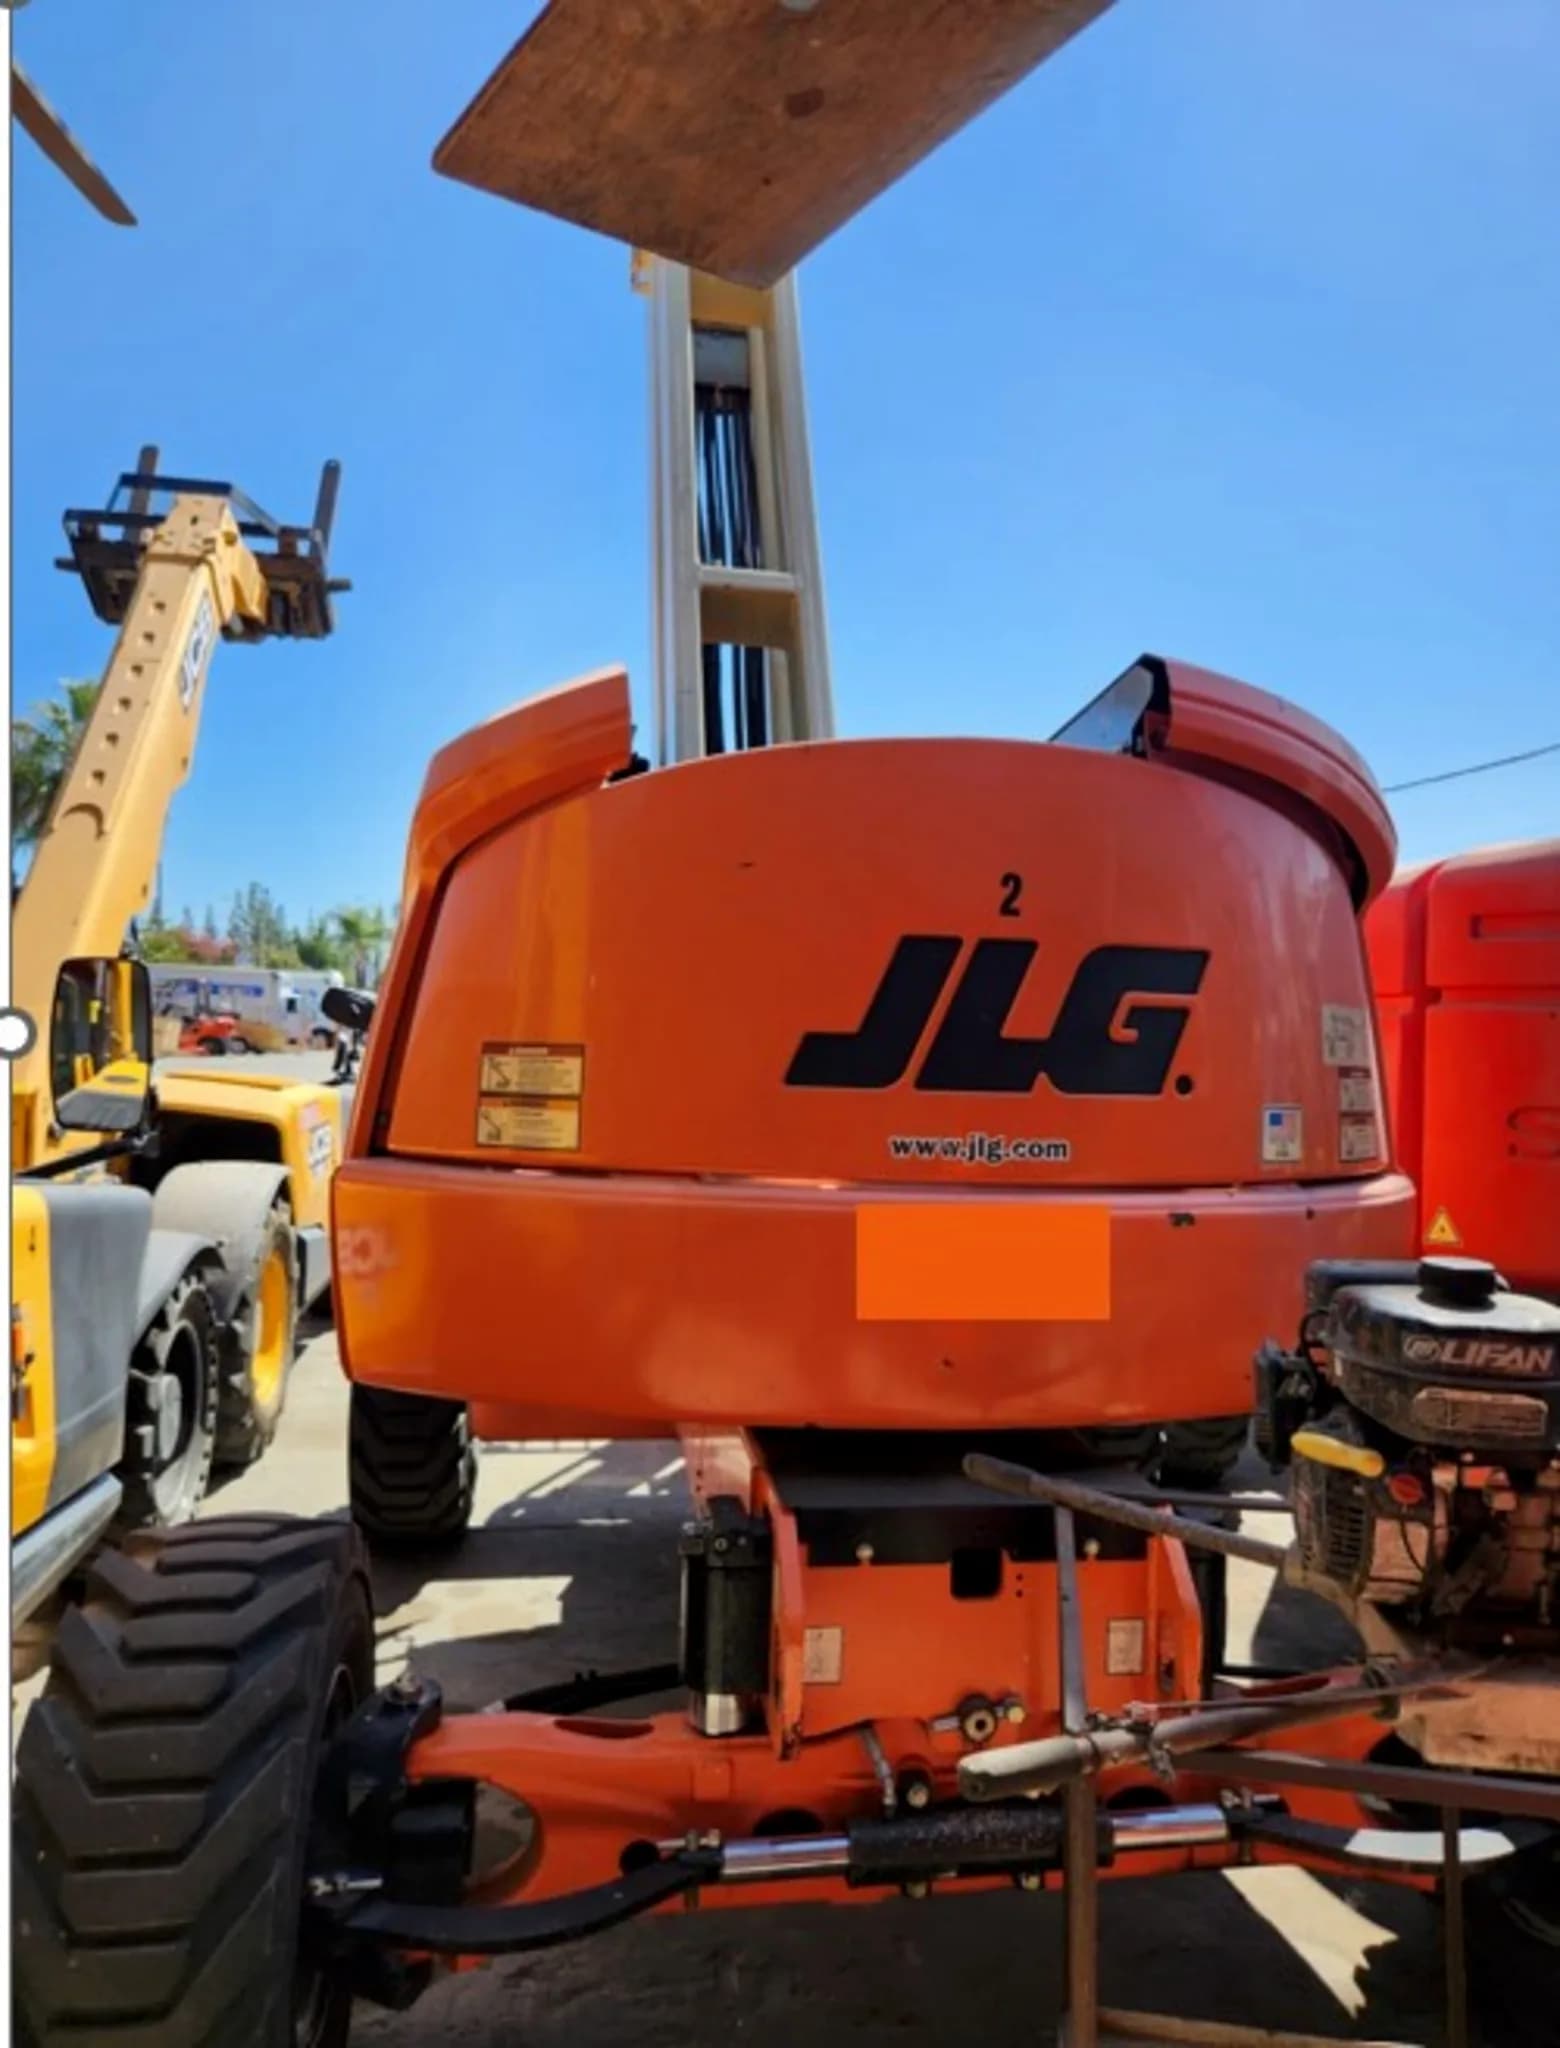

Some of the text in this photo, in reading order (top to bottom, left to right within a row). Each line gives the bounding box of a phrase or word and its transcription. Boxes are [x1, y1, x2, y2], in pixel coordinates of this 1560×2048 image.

[999, 872, 1021, 916] 2
[890, 1134, 1069, 1163] www.jlg.com
[1439, 1339, 1553, 1373] LIFAN
